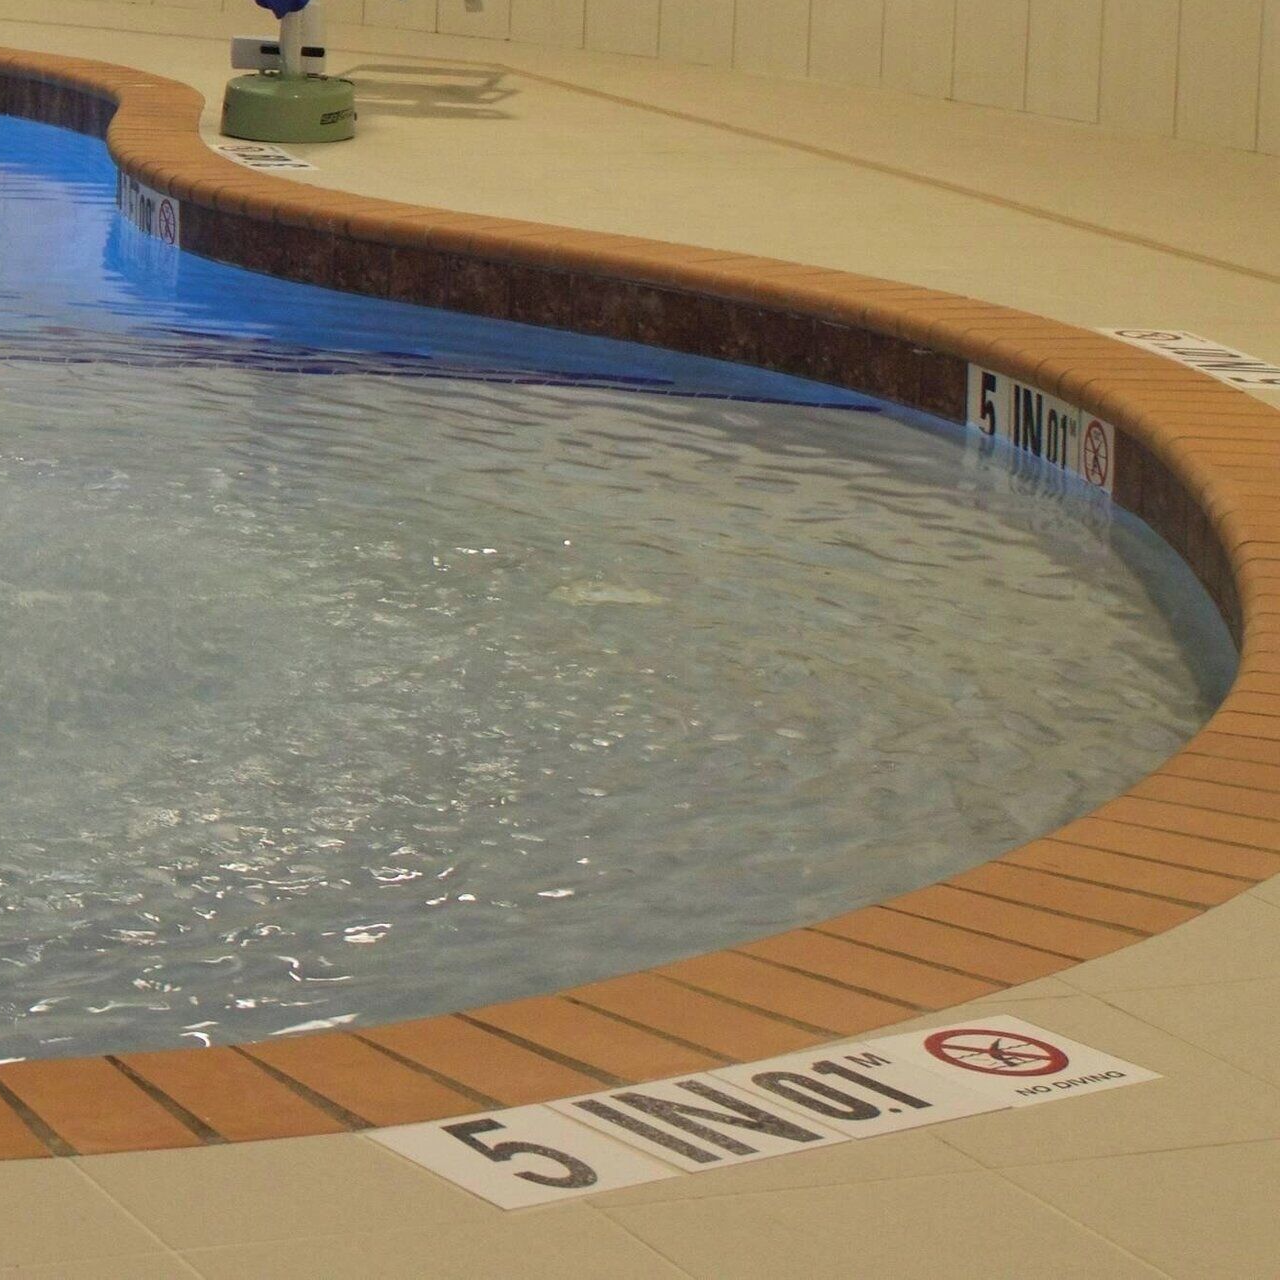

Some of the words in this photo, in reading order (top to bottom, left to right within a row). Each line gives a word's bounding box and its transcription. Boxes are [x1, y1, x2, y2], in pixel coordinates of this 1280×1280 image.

[979, 371, 997, 436] 5
[1013, 384, 1043, 458] IN
[1015, 1085, 1052, 1097] NO
[1052, 1070, 1127, 1090] DIVING
[440, 1118, 598, 1189] 5
[571, 1079, 825, 1164] IN
